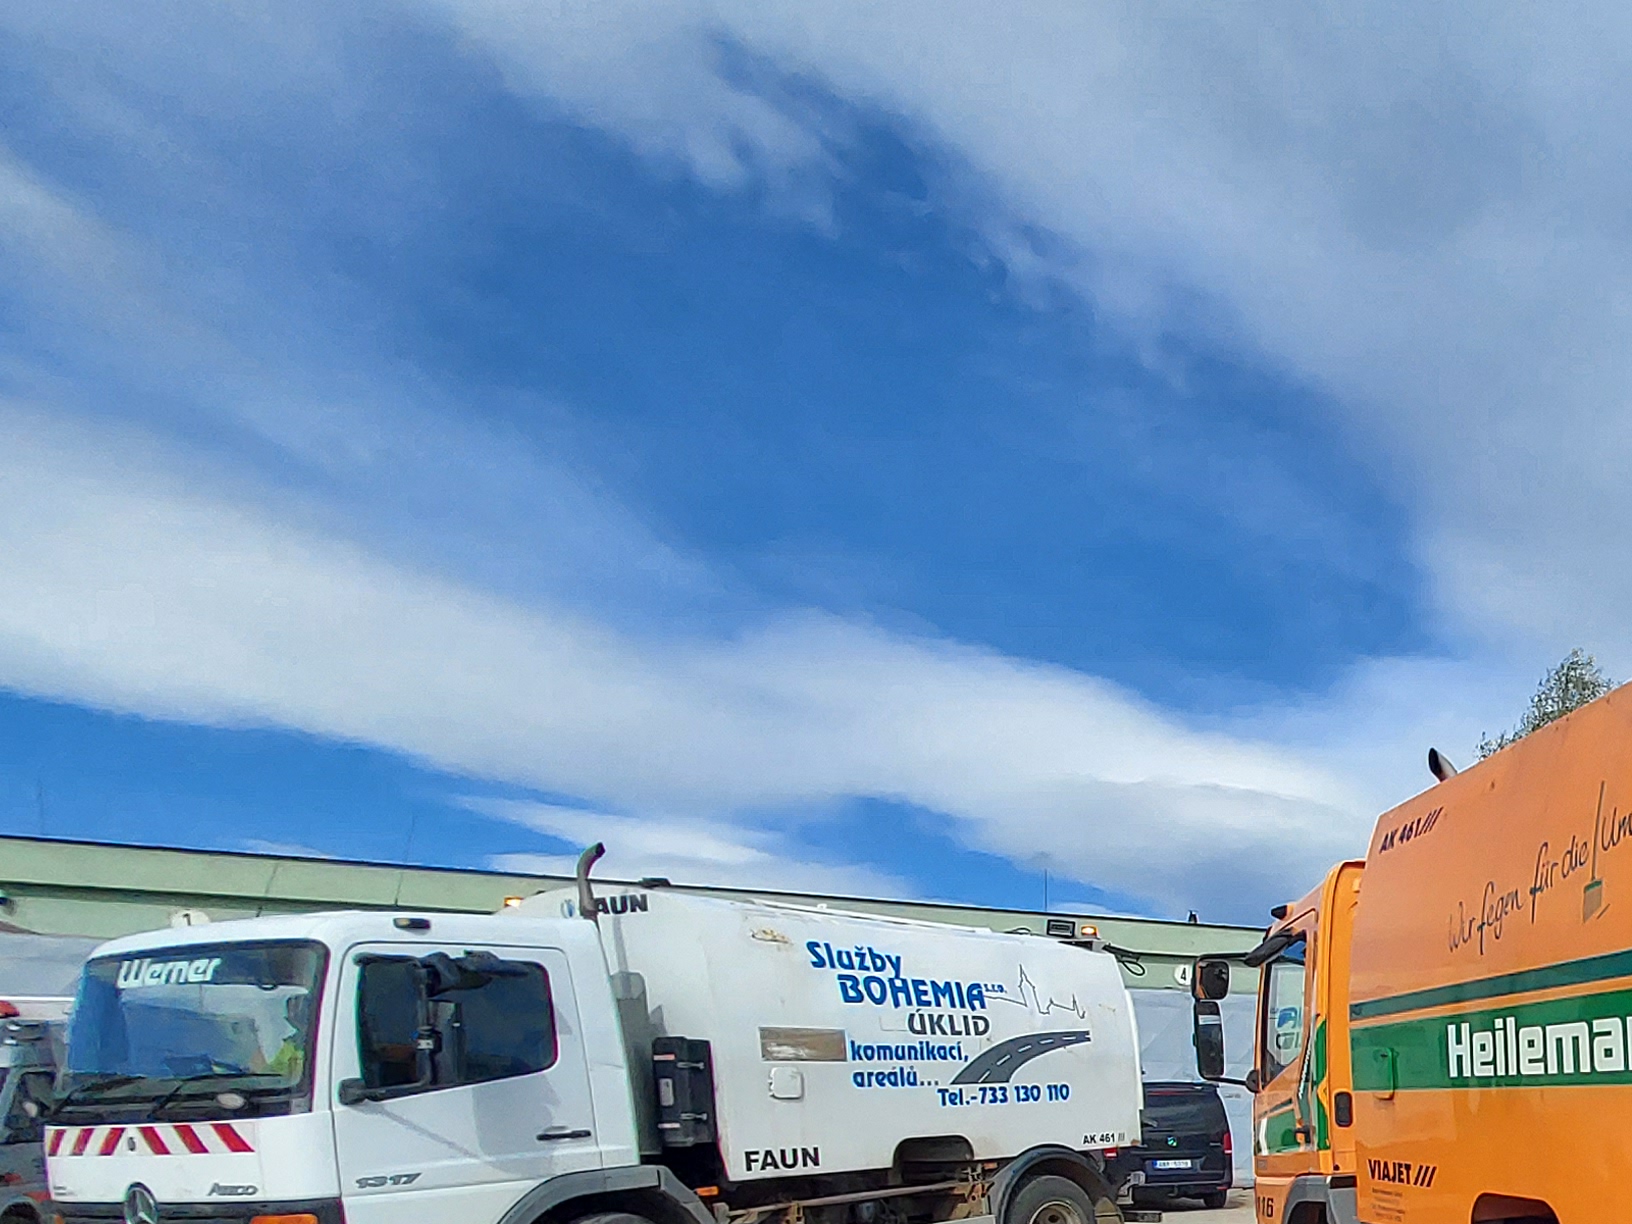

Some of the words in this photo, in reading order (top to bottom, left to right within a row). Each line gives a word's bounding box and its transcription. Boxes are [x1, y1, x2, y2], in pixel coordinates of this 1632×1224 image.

[1379, 827, 1400, 854] AK
[593, 894, 648, 914] AUN
[1477, 881, 1523, 955] fegen
[1530, 841, 1559, 924] für
[1561, 835, 1589, 878] die
[117, 957, 222, 989] Werner
[806, 941, 901, 979] Služby
[1180, 967, 1187, 981] 4
[837, 974, 987, 1011] BOHEMIA
[907, 1009, 990, 1036] ÚKLID
[850, 1040, 969, 1062] komunikací,
[1015, 1085, 1041, 1103] 130
[1046, 1083, 1070, 1101] 110
[1083, 1134, 1097, 1144] AK
[1099, 1132, 1115, 1142] 461
[744, 1147, 820, 1172] FAUN
[1367, 1158, 1412, 1185] VIAJET
[355, 1172, 422, 1189] 1317
